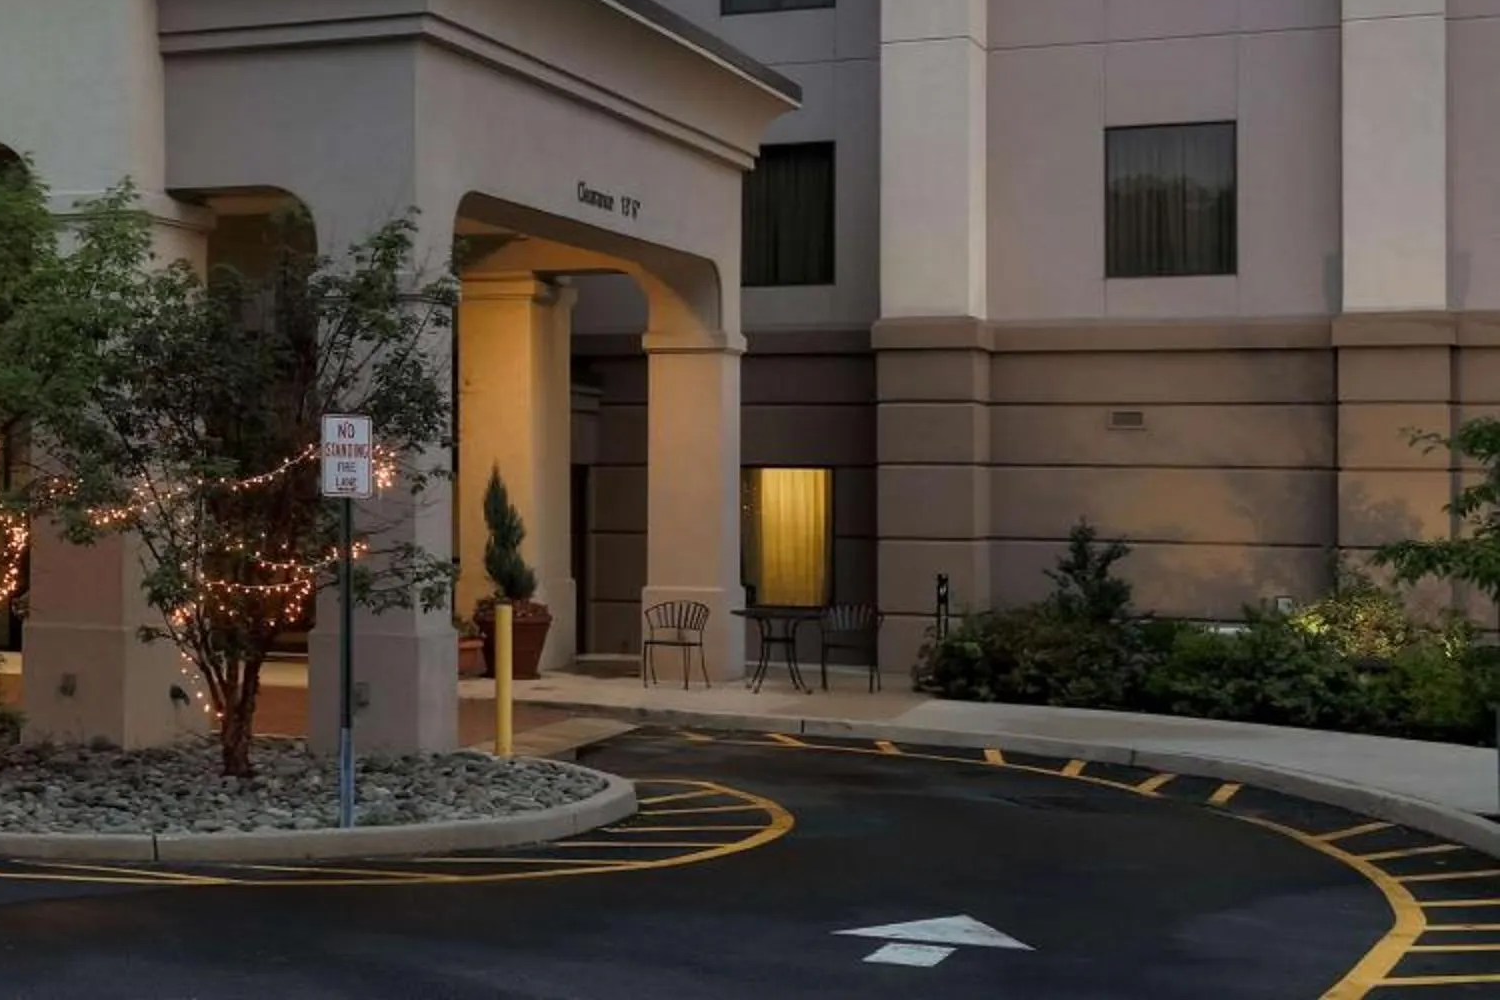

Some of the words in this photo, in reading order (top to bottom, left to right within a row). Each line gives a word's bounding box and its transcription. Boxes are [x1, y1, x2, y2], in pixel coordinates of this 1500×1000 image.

[337, 423, 356, 439] NO
[325, 442, 370, 458] STANDING
[337, 461, 357, 473] FIRE
[335, 477, 357, 487] LANE
